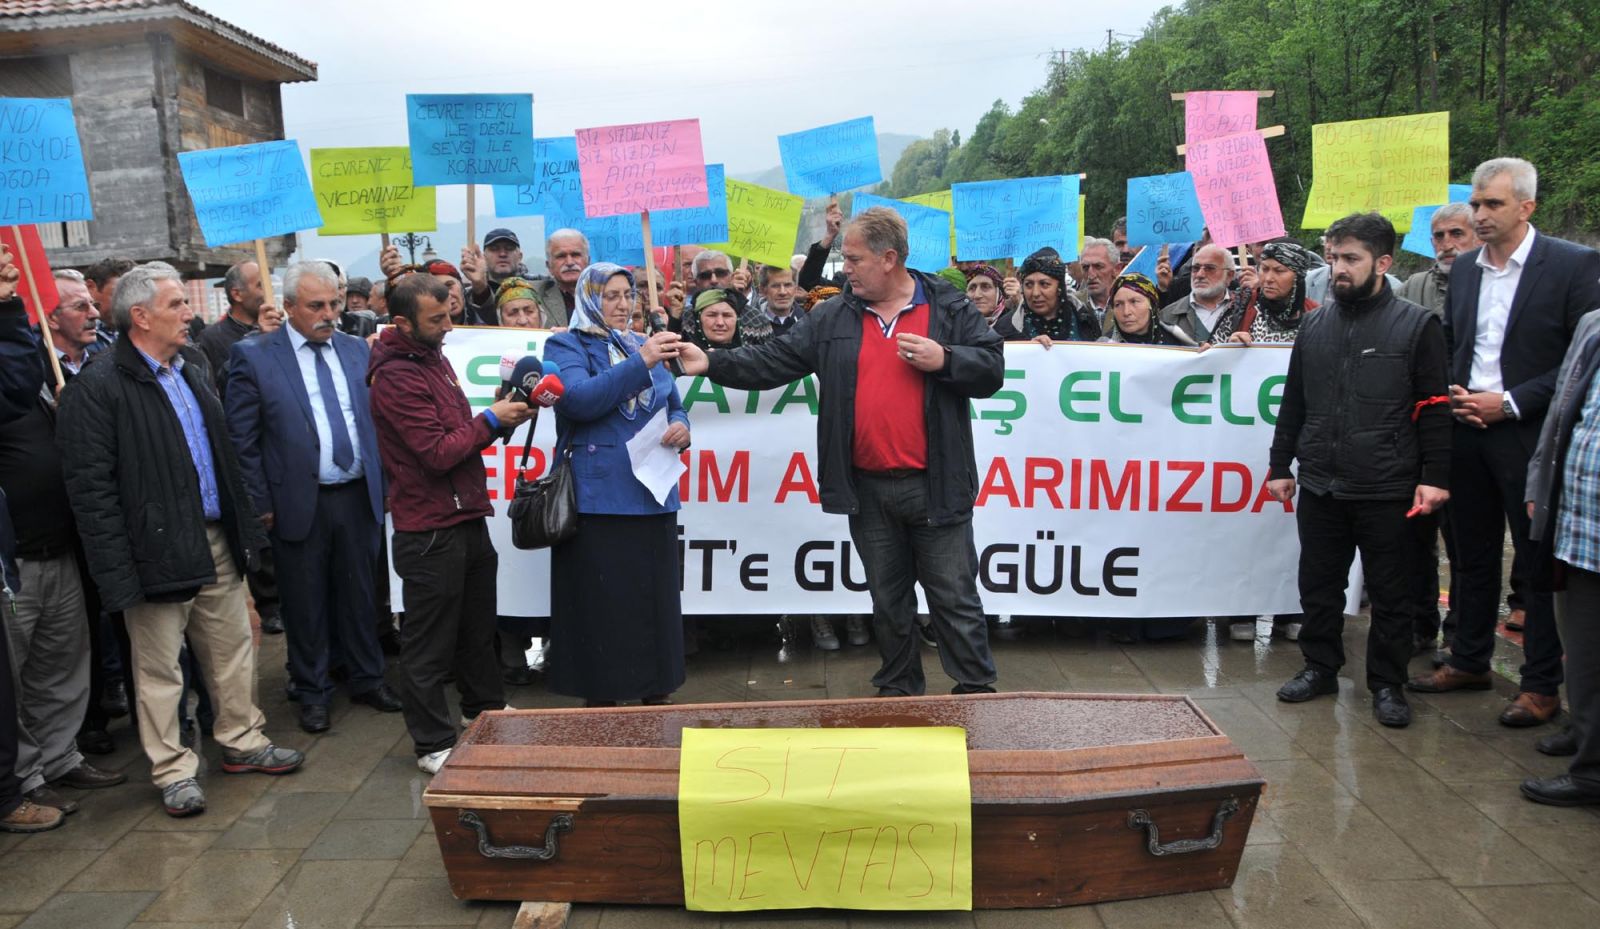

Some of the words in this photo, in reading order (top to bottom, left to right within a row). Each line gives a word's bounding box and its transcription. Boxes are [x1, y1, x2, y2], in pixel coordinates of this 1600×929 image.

[447, 156, 521, 176] KORUNUR
[605, 161, 656, 185] AMA
[1152, 216, 1191, 234] OLUR
[731, 236, 778, 256] HAYAT
[1059, 370, 1142, 424] EL
[978, 530, 1140, 597] GÜLE
[692, 822, 957, 900] MEVTASI
